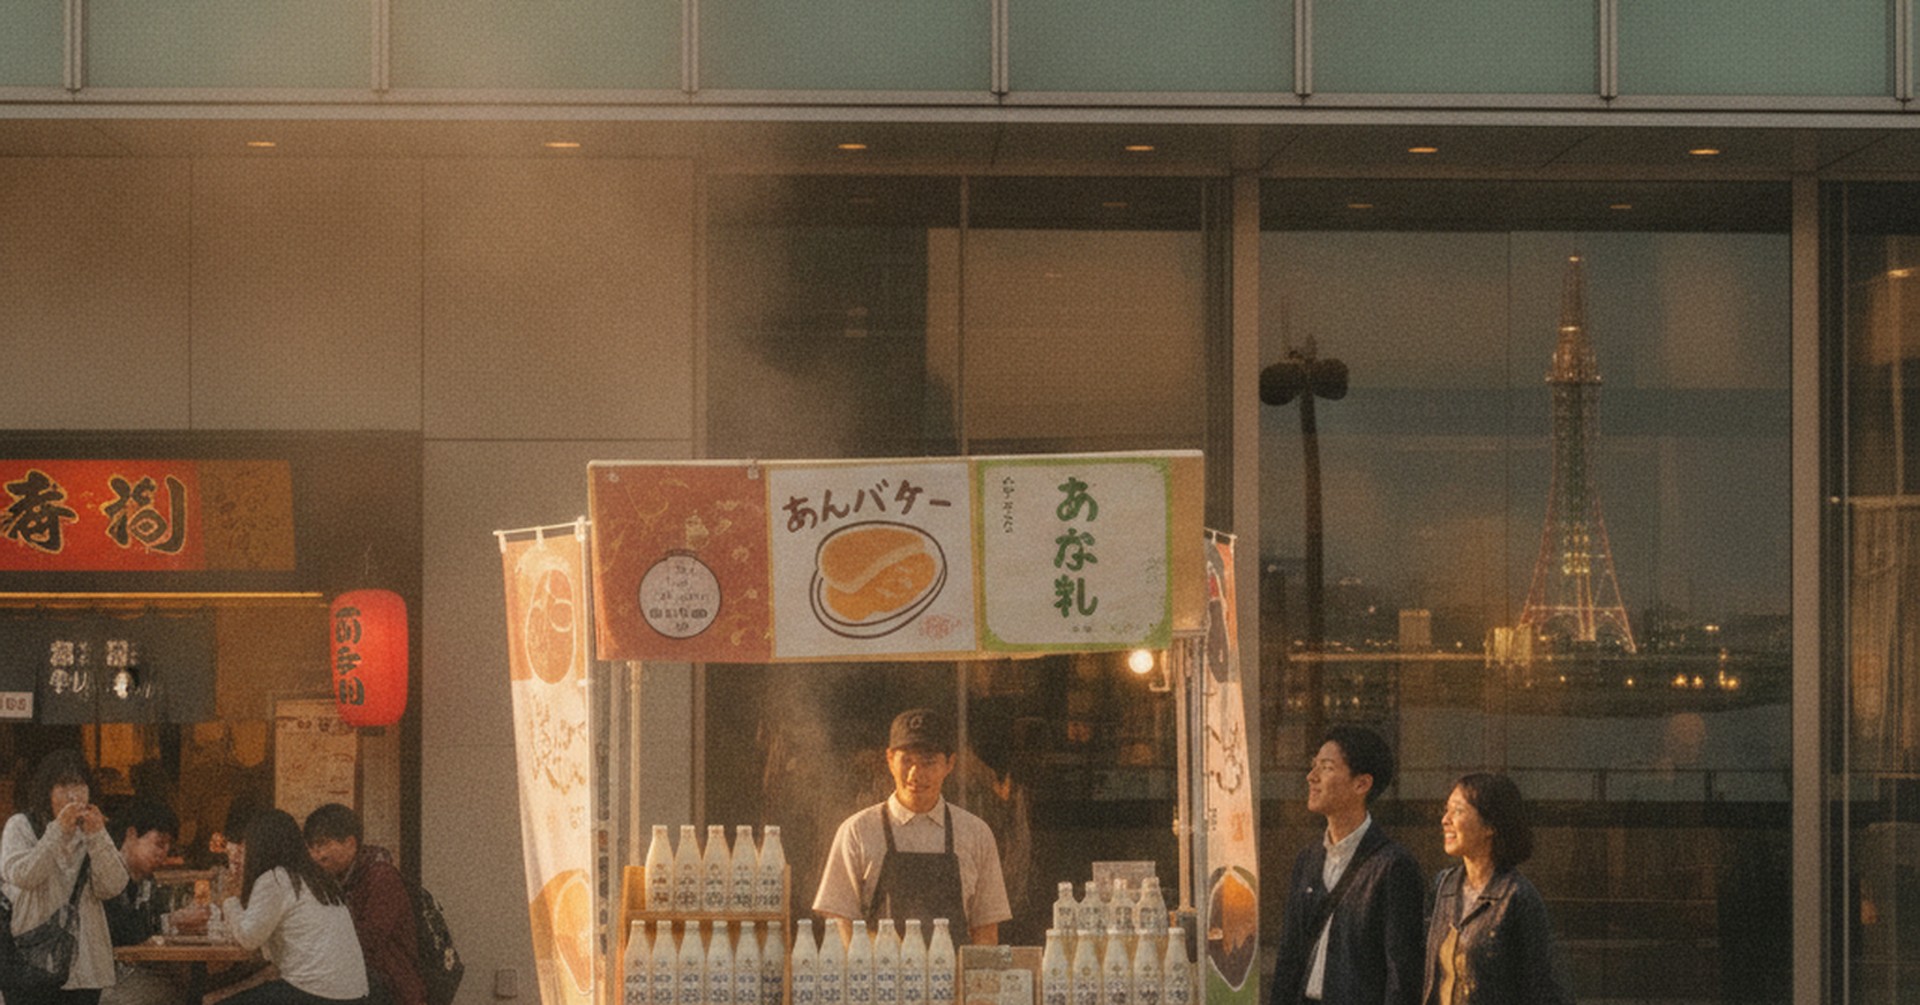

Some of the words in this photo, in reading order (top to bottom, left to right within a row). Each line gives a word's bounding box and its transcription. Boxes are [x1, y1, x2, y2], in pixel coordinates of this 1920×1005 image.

[782, 478, 952, 533] あんバター
